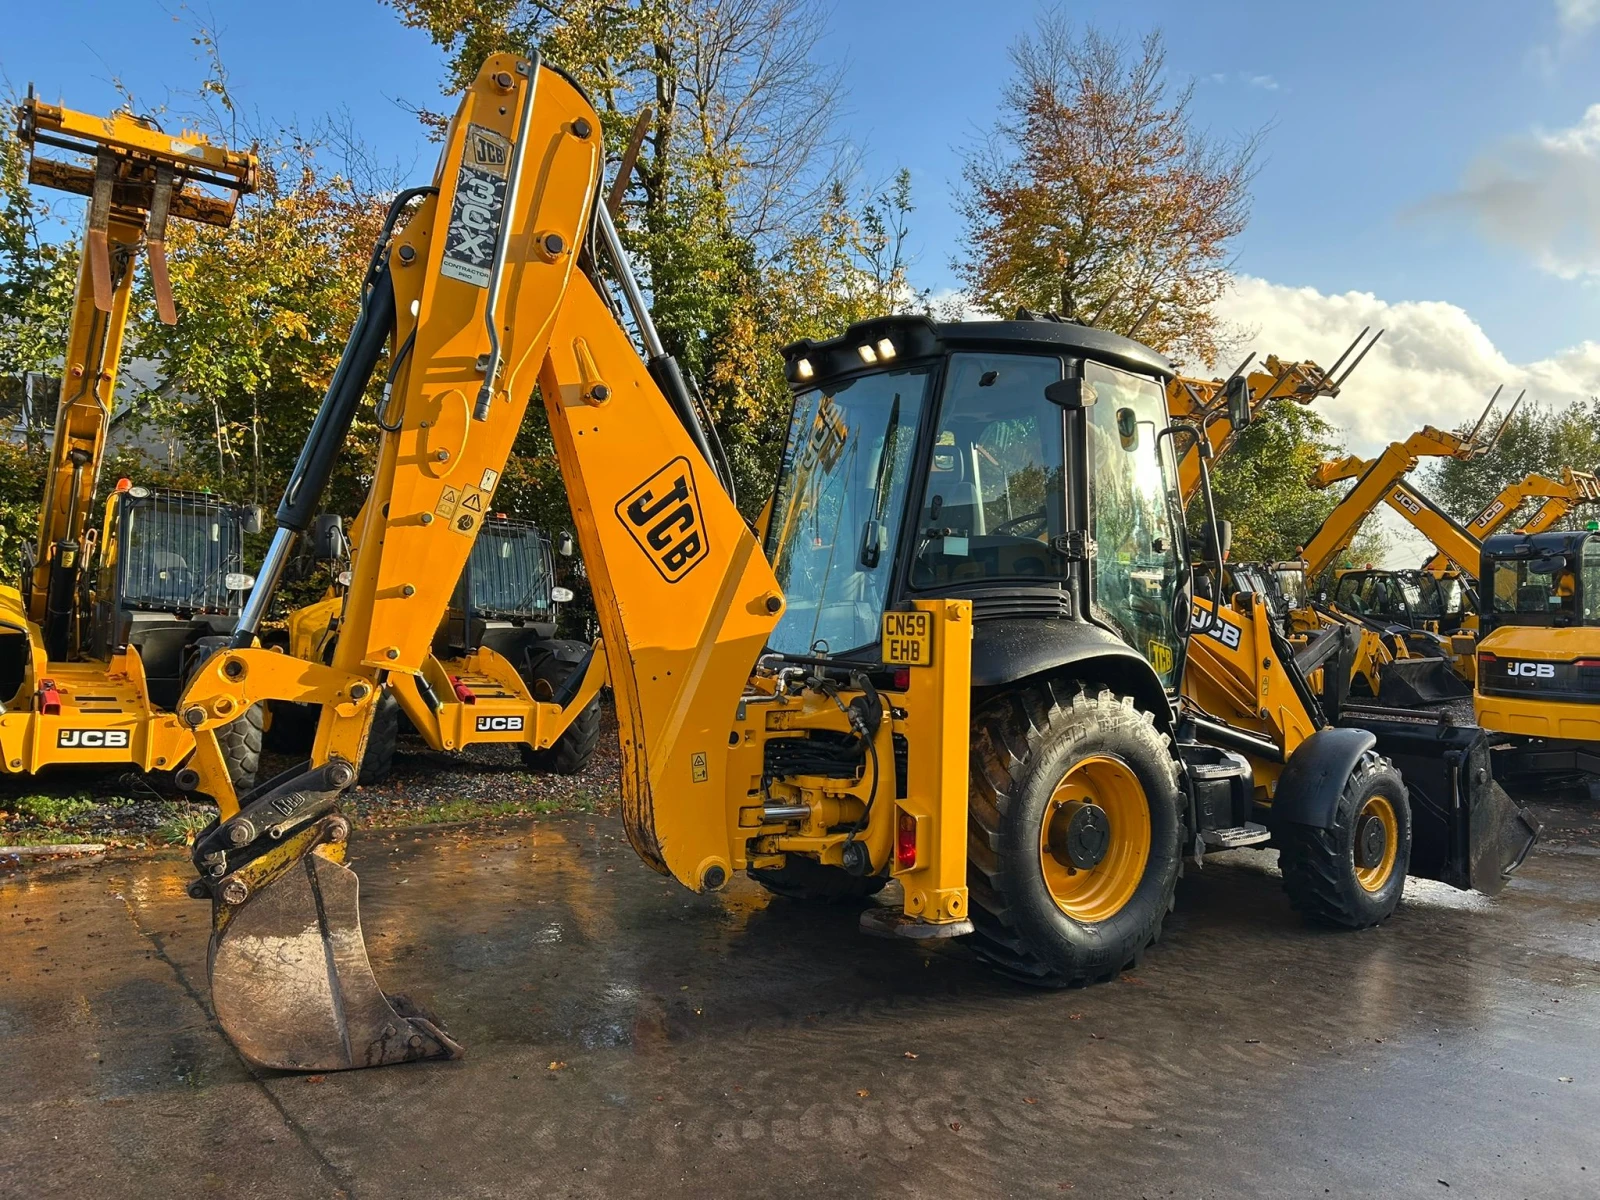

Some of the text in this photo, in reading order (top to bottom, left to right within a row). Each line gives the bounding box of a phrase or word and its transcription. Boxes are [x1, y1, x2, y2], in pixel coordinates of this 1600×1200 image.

[475, 138, 504, 165] JCB
[453, 178, 496, 259] 3CX
[443, 260, 489, 278] CONTRACTOR
[458, 271, 473, 280] PRO
[1394, 491, 1420, 515] JCB
[1477, 500, 1505, 528] JCB
[626, 474, 701, 572] JCB
[1532, 512, 1547, 527] JCB
[886, 614, 926, 637] CN59
[1191, 606, 1240, 647] JCB
[890, 639, 920, 661] EHB
[1152, 645, 1172, 674] JCB
[1507, 662, 1555, 678] JCB
[478, 717, 523, 730] JCB
[60, 730, 127, 746] JCB
